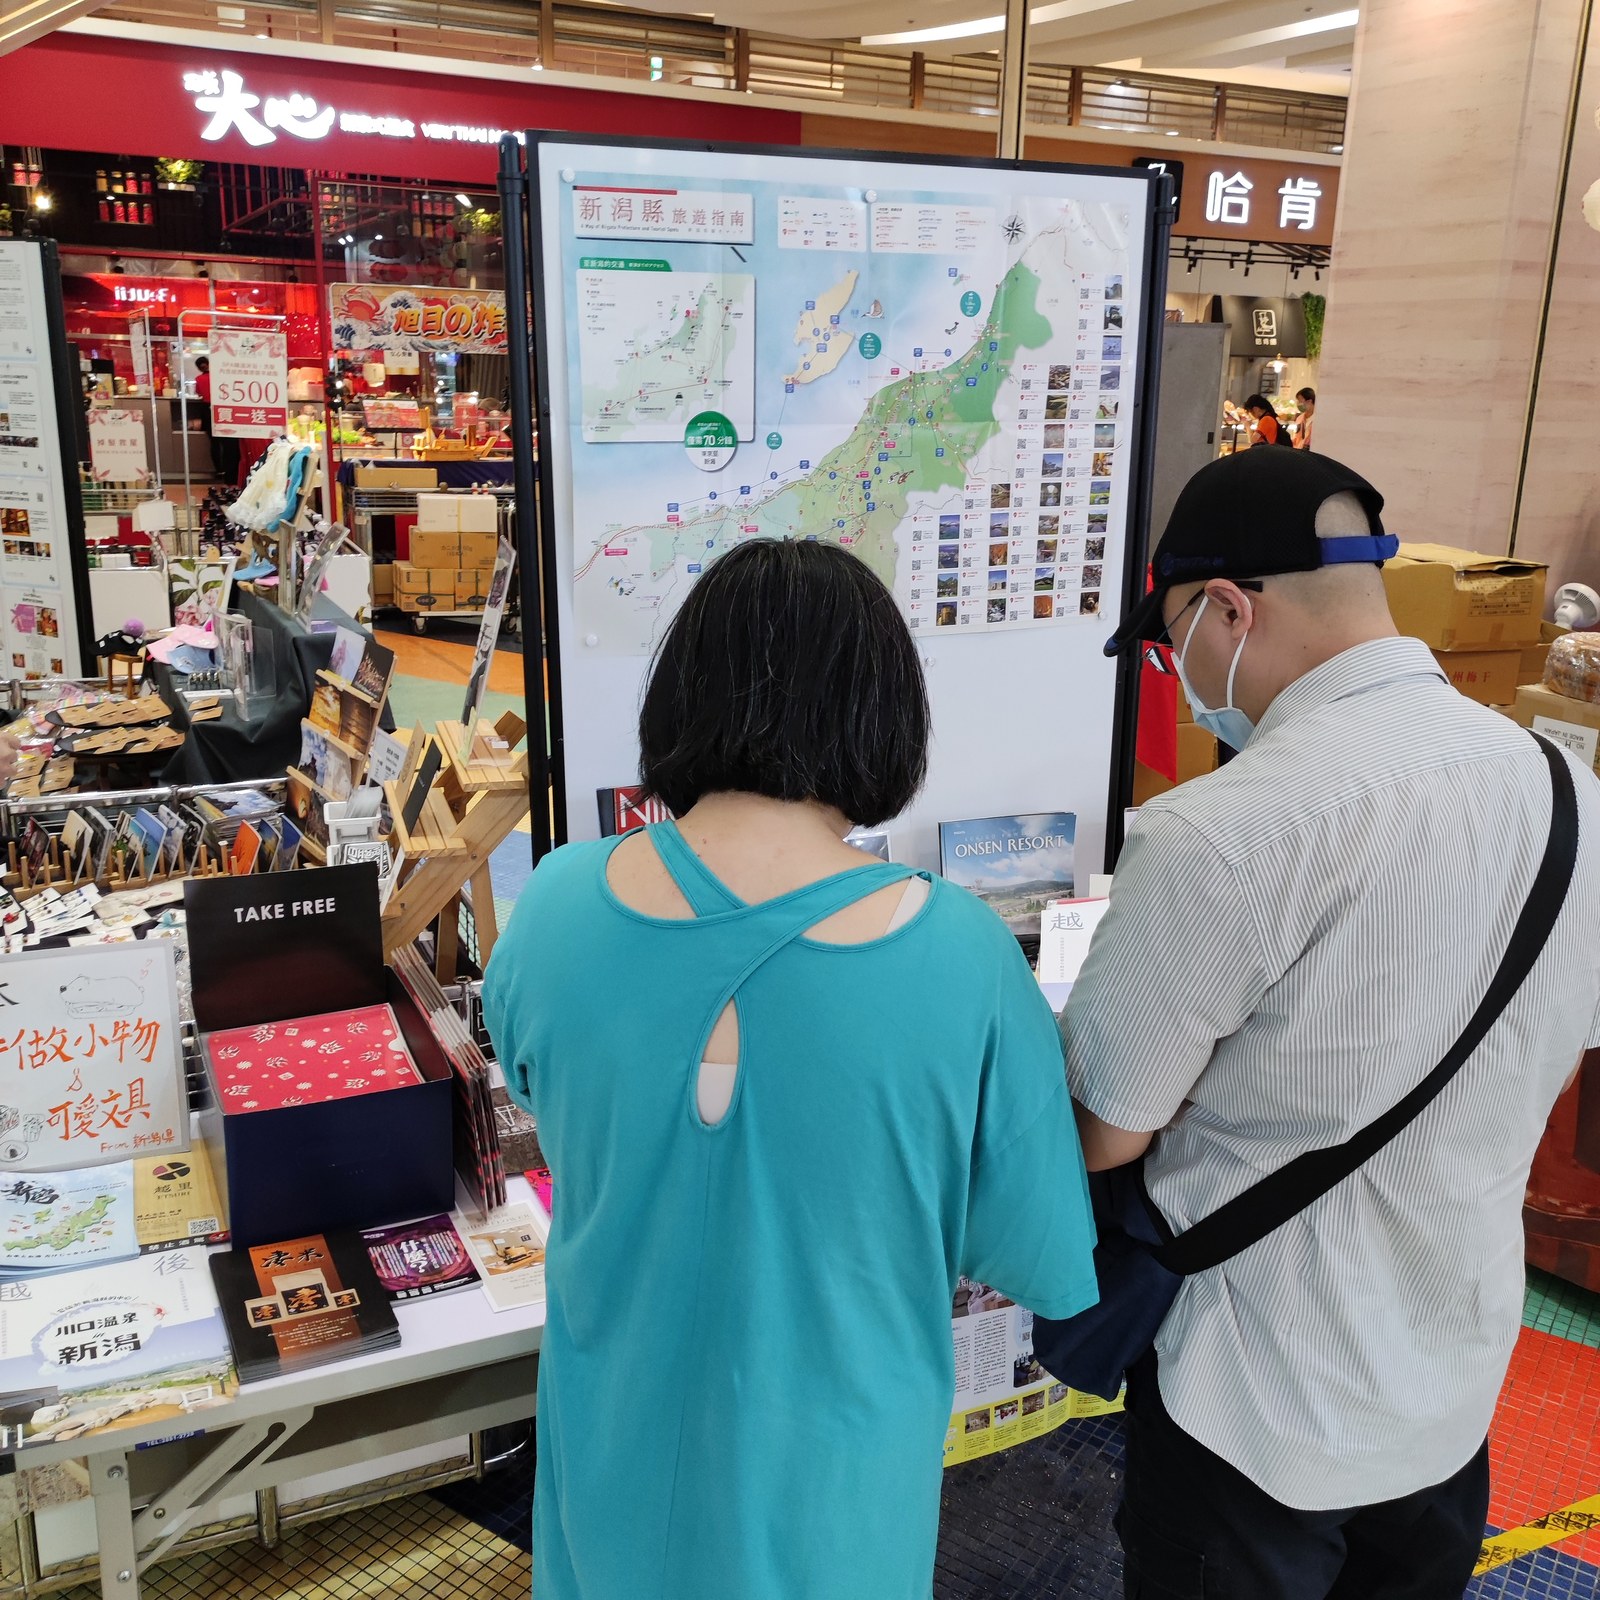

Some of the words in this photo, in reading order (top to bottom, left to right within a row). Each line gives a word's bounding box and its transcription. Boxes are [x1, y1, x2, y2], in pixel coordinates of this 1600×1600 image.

[579, 195, 665, 224] 新潟縣
[671, 207, 745, 228] 旅遊指南
[1206, 171, 1322, 230] 哈肯
[218, 381, 280, 404] $500
[217, 407, 283, 424] 買一送一
[703, 434, 716, 446] 70
[1446, 670, 1494, 684] 州梅干
[1544, 727, 1561, 737] JAPAN
[1569, 733, 1584, 742] MADE
[955, 840, 1002, 857] ONSEN
[1007, 834, 1064, 852] RESORT
[235, 901, 284, 923] TAKE
[292, 897, 337, 919] FREE
[1049, 911, 1085, 932] 越
[0, 1018, 161, 1071] 做小物
[46, 1077, 151, 1142] 可愛文具
[100, 1141, 130, 1153] From
[153, 1252, 195, 1276] 後
[58, 1332, 142, 1365] 新潟
